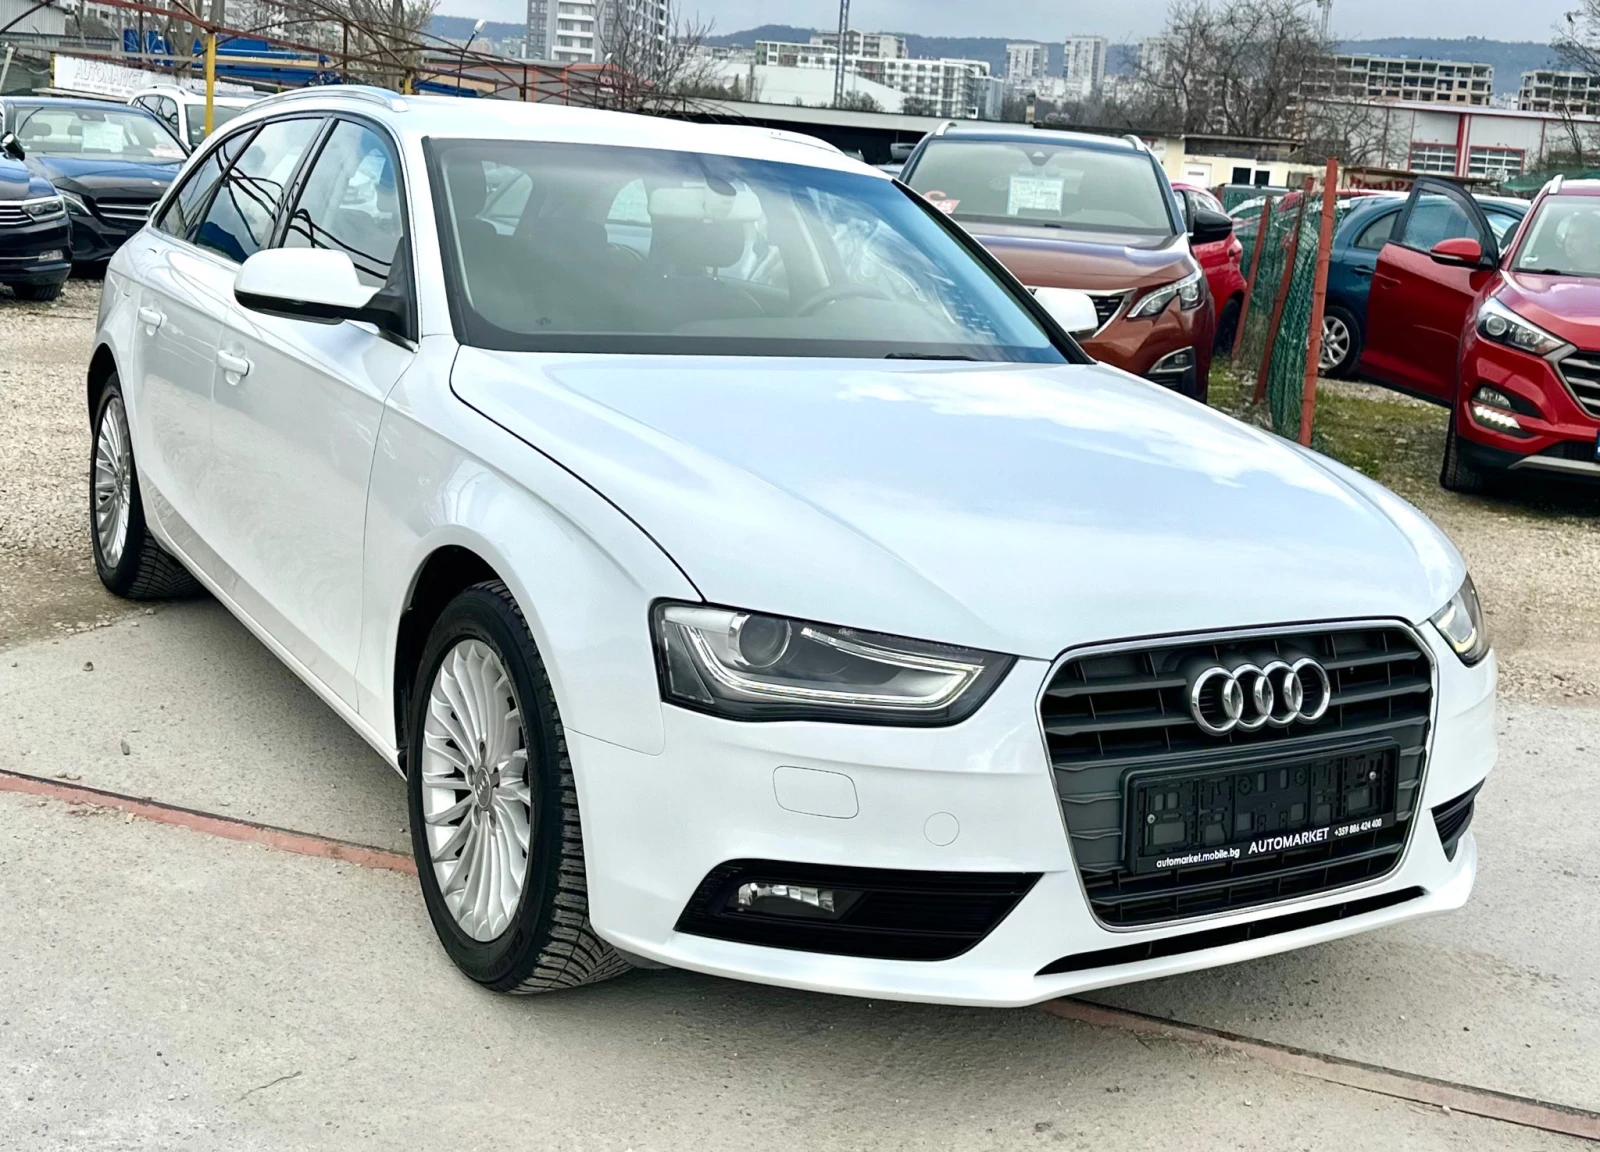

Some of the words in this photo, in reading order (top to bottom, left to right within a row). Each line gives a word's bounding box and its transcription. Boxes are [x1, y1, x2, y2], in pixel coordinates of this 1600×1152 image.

[1156, 847, 1240, 868] automarket.mobile.bg
[1248, 826, 1330, 855] AUTOMARKET
[1334, 825, 1349, 837] +359
[1360, 820, 1371, 831] 424
[1371, 817, 1382, 828] 400
